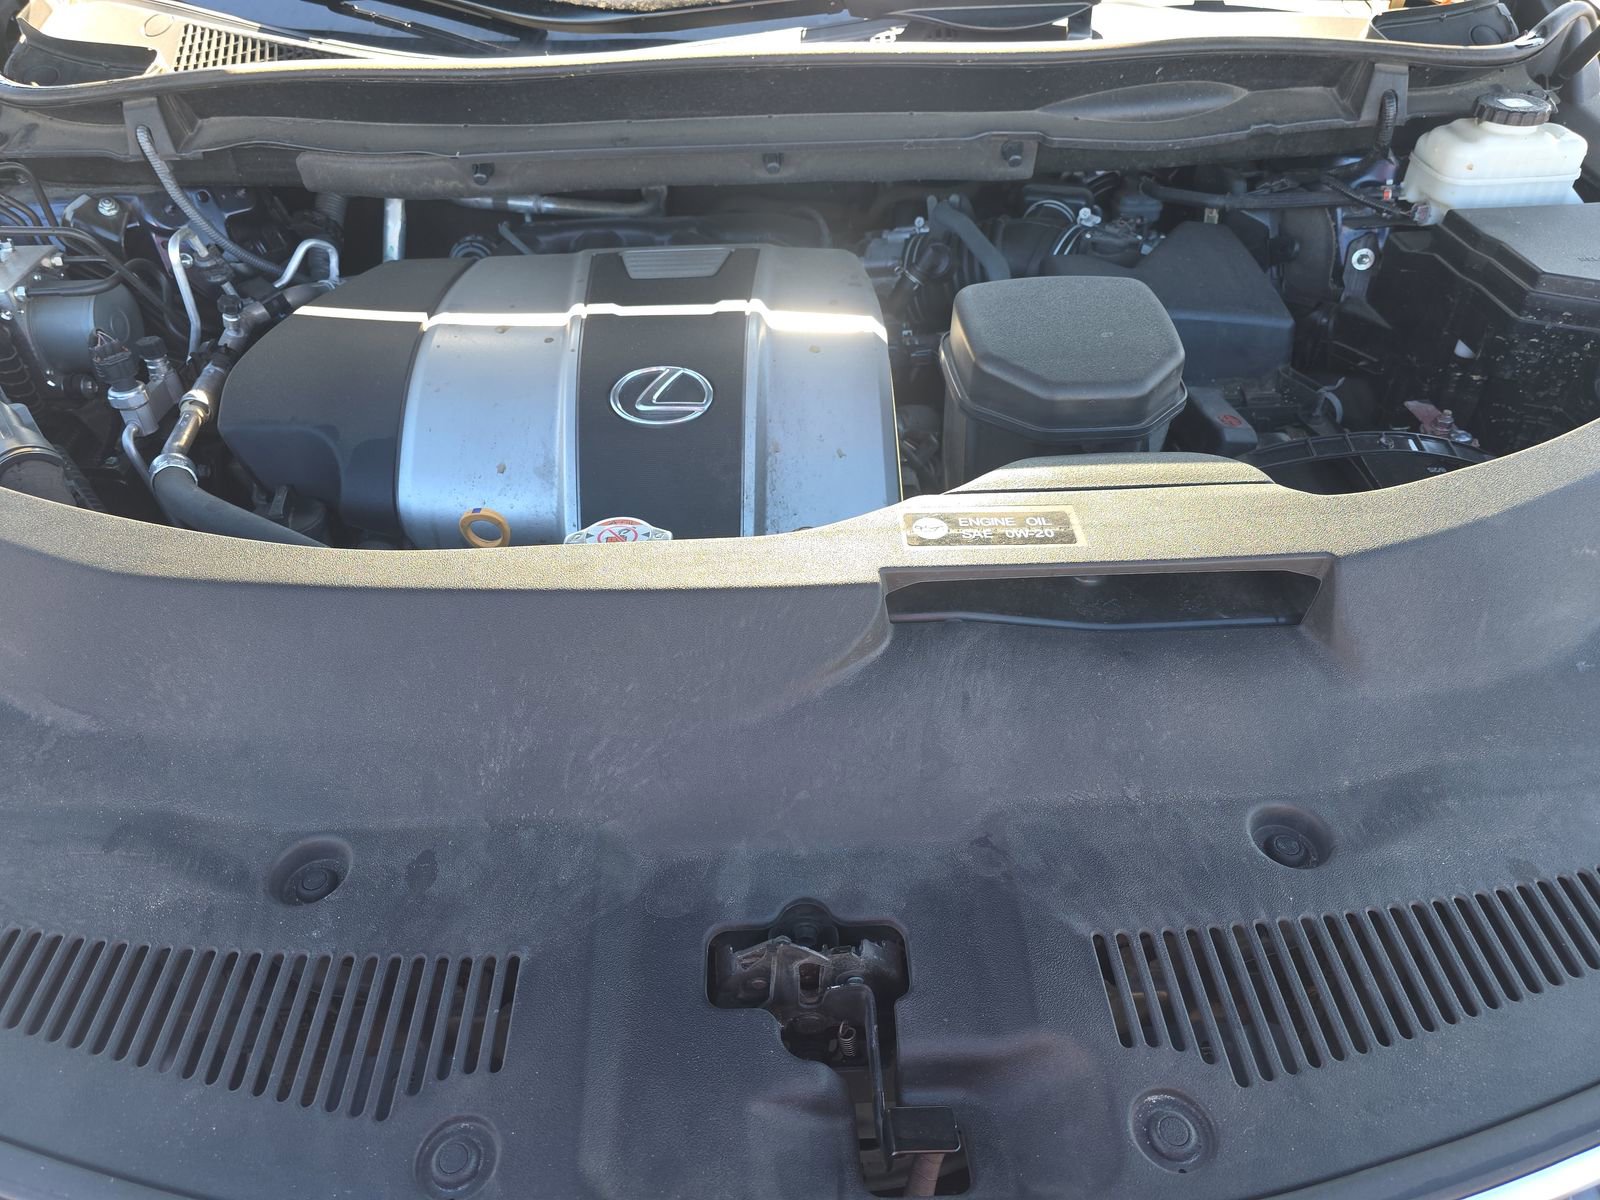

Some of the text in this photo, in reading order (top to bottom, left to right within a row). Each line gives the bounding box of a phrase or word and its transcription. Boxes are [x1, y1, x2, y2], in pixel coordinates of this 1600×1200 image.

[959, 517, 1052, 526] ENGINE OIL
[962, 529, 1054, 538] SAE 0W-20
